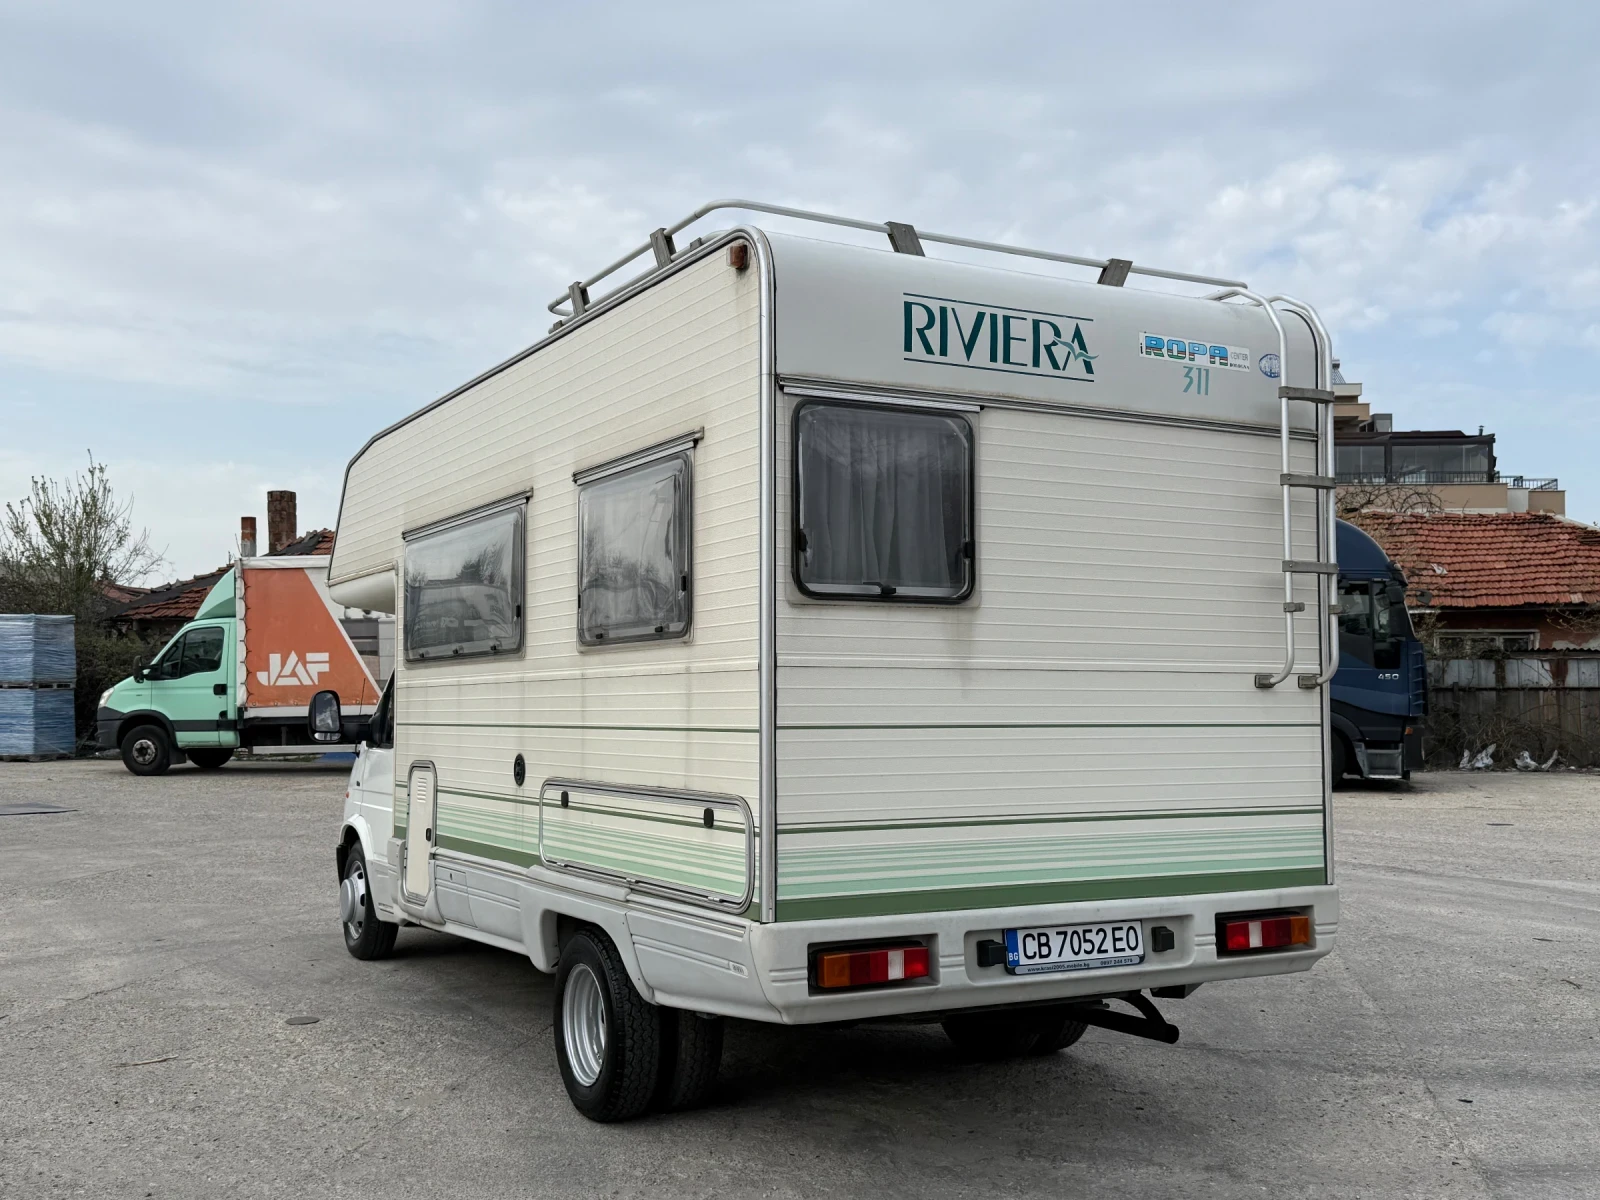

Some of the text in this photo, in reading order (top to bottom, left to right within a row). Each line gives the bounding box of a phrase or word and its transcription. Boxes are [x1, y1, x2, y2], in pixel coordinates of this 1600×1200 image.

[903, 301, 1095, 375] RIVIERA
[1182, 366, 1210, 396] 311
[256, 650, 330, 686] JAF
[1008, 952, 1019, 961] BG
